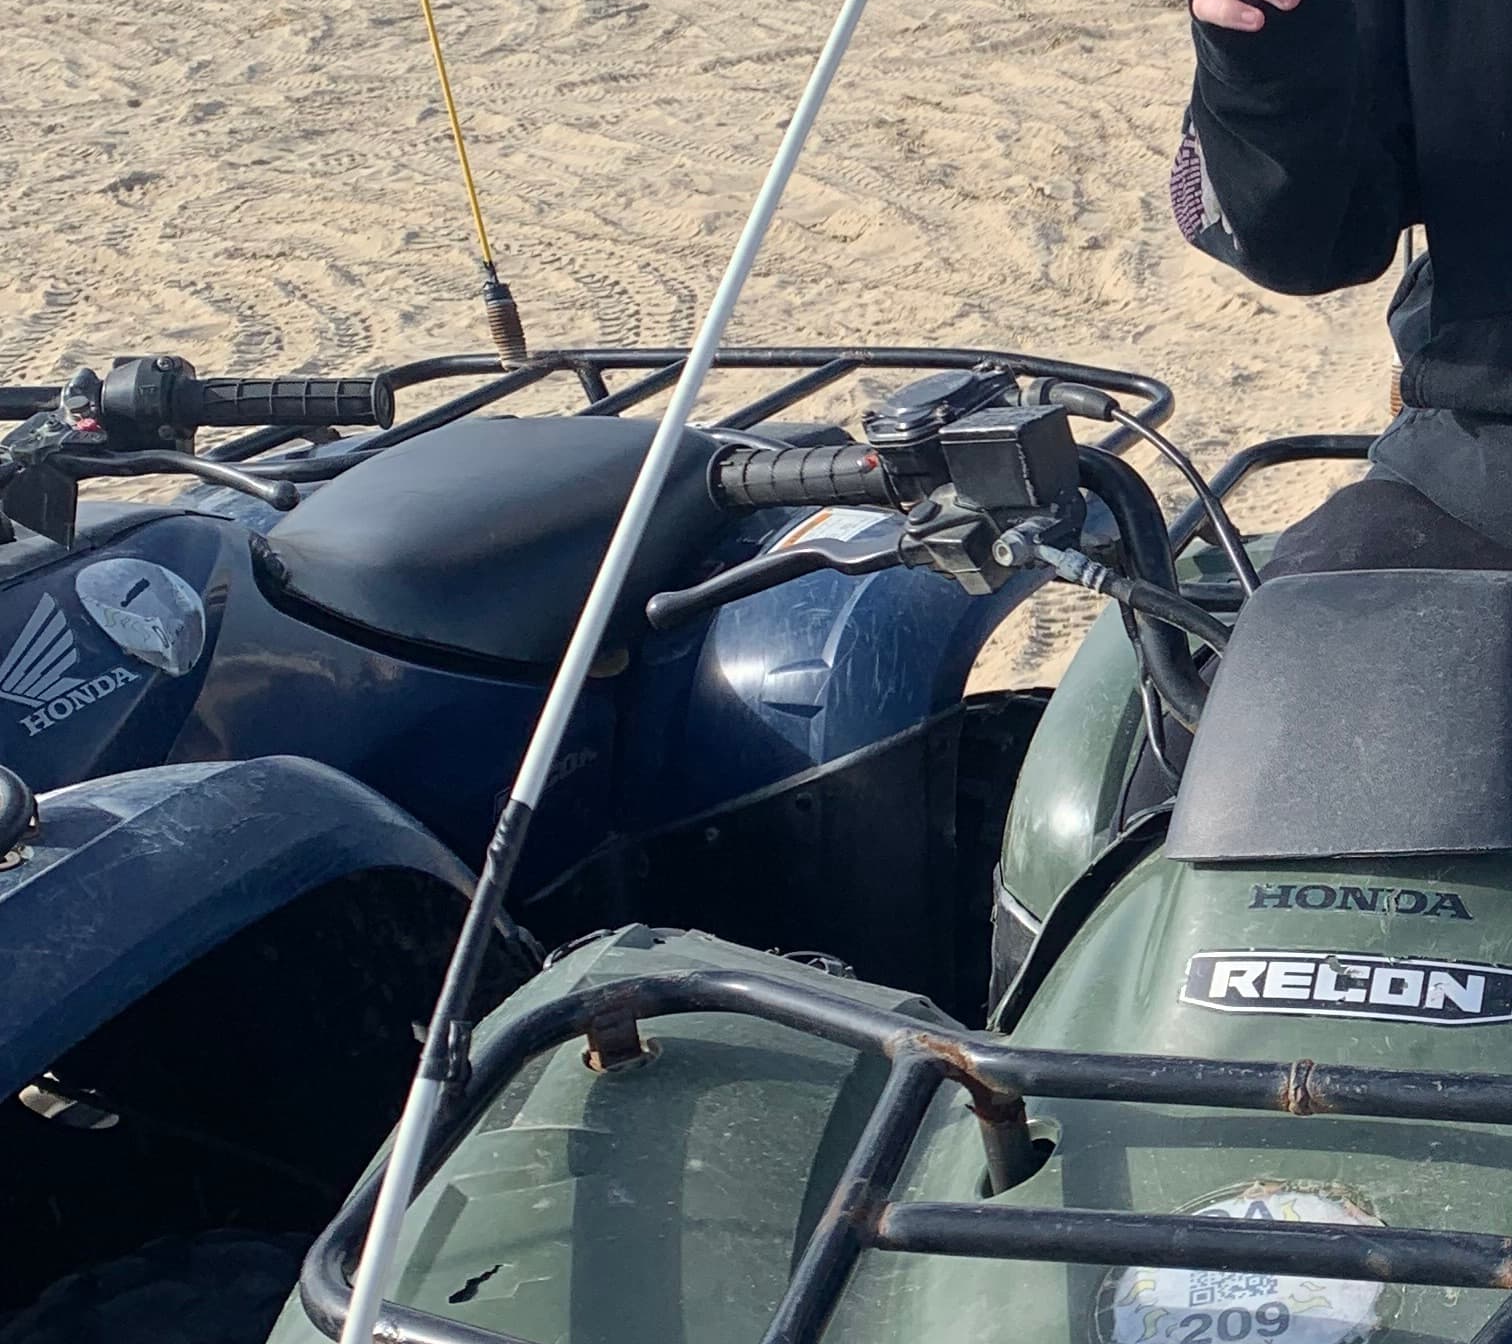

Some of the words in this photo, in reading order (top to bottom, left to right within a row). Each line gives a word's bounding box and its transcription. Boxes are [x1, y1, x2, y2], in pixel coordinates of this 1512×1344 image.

[19, 667, 140, 736] HONDA
[1248, 884, 1474, 920] HONDA
[1208, 960, 1485, 1014] RECON
